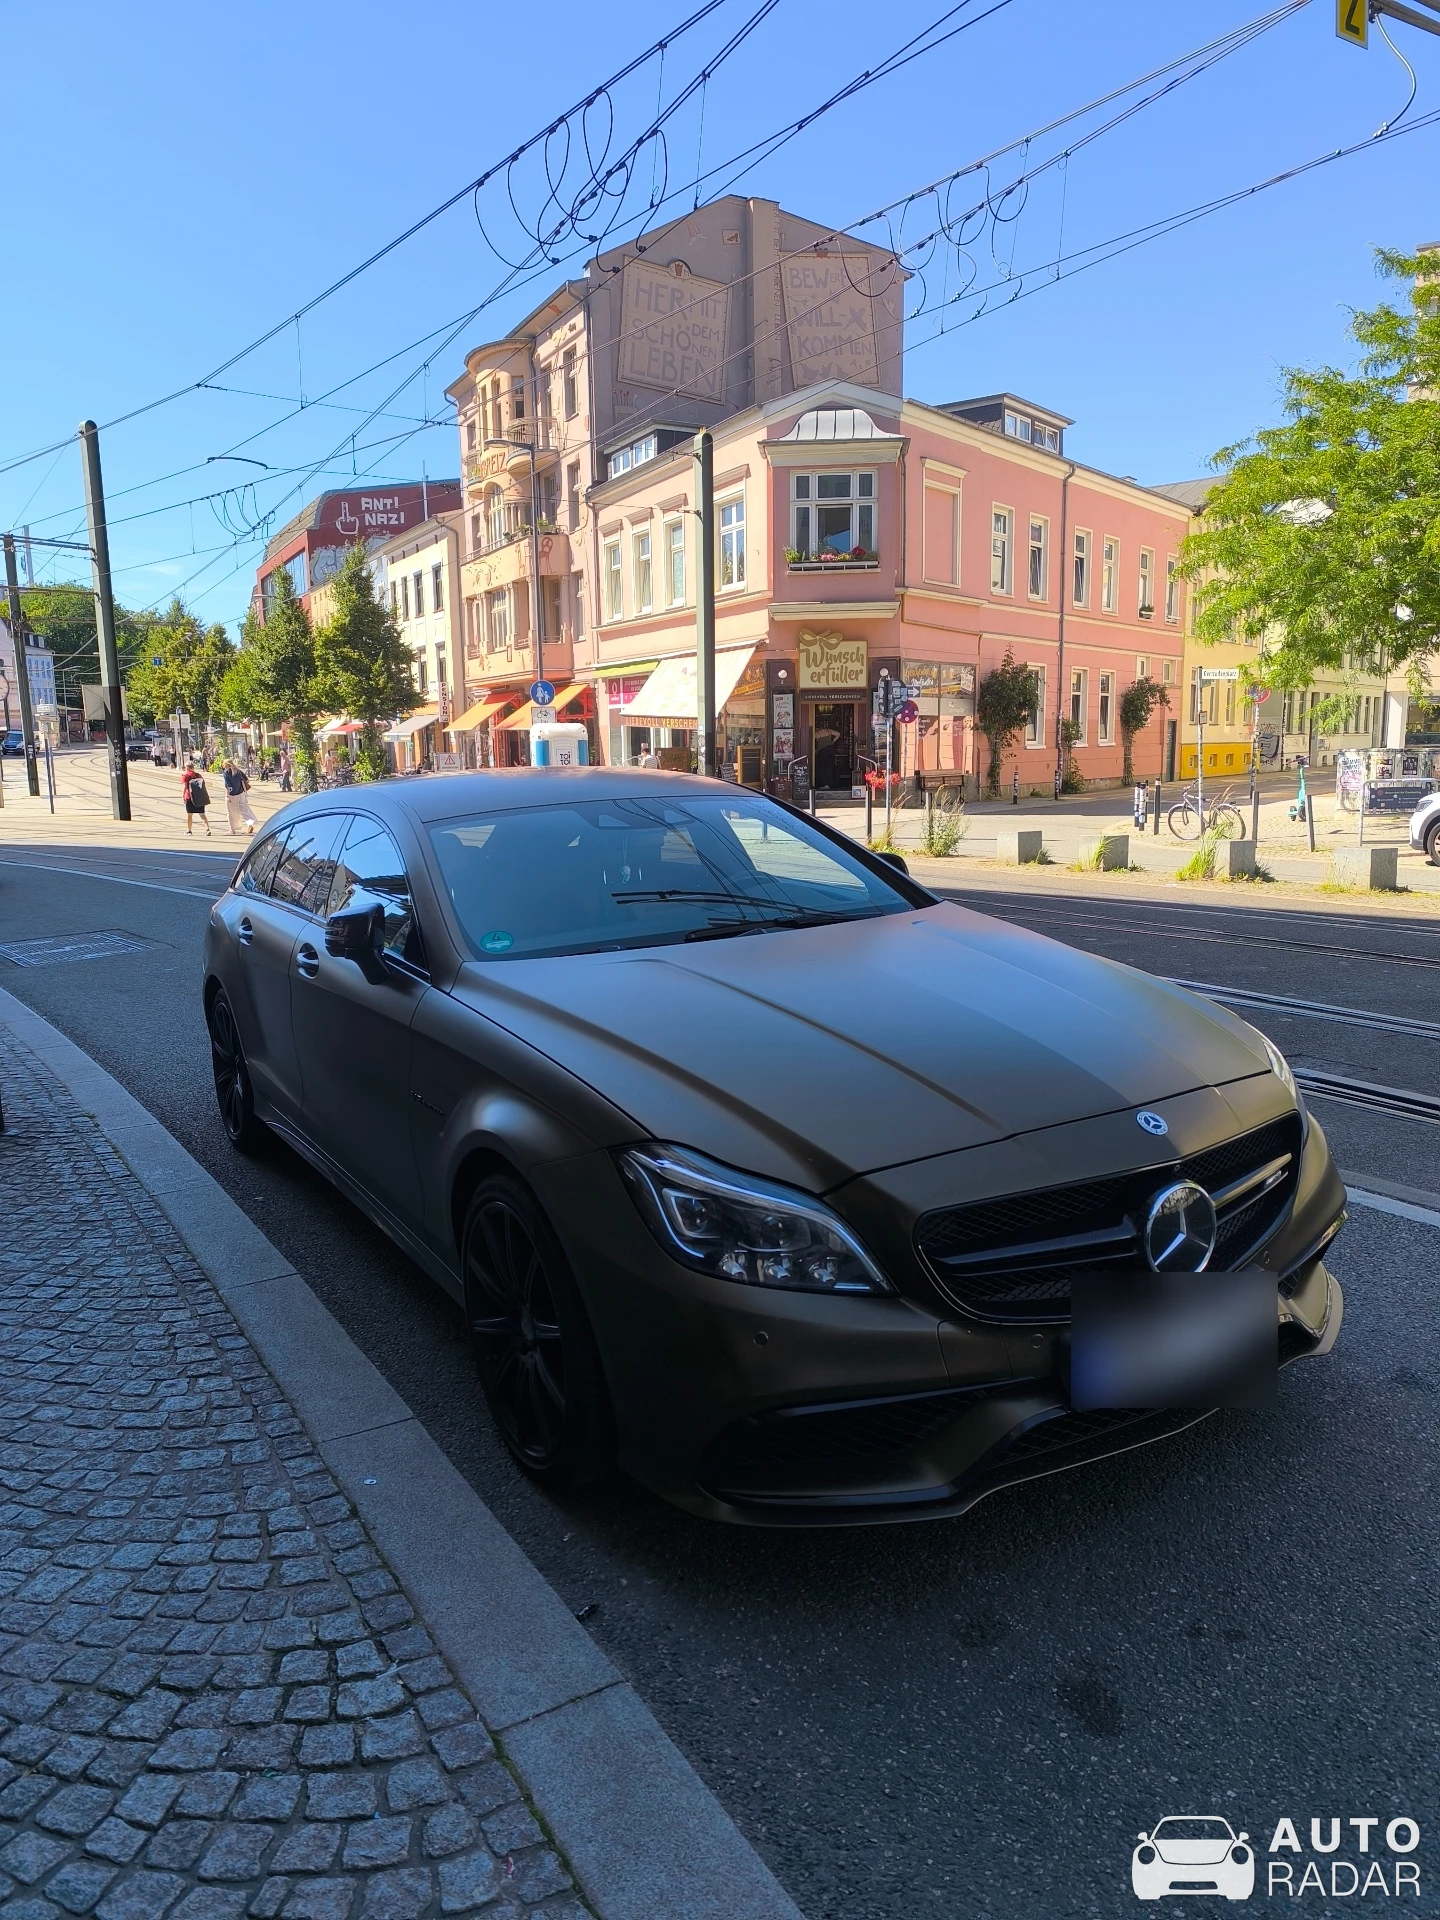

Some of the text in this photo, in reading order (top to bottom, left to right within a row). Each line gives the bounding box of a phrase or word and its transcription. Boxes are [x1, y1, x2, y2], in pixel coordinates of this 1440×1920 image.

[692, 323, 720, 342] DEM
[797, 335, 872, 357] KOMMEN
[630, 342, 716, 392] LEBEN
[364, 512, 404, 526] NAZI
[799, 643, 864, 668] Wunsch
[810, 662, 863, 686] erfüller
[626, 717, 698, 728] LIEBEVOLL VERSCHEN
